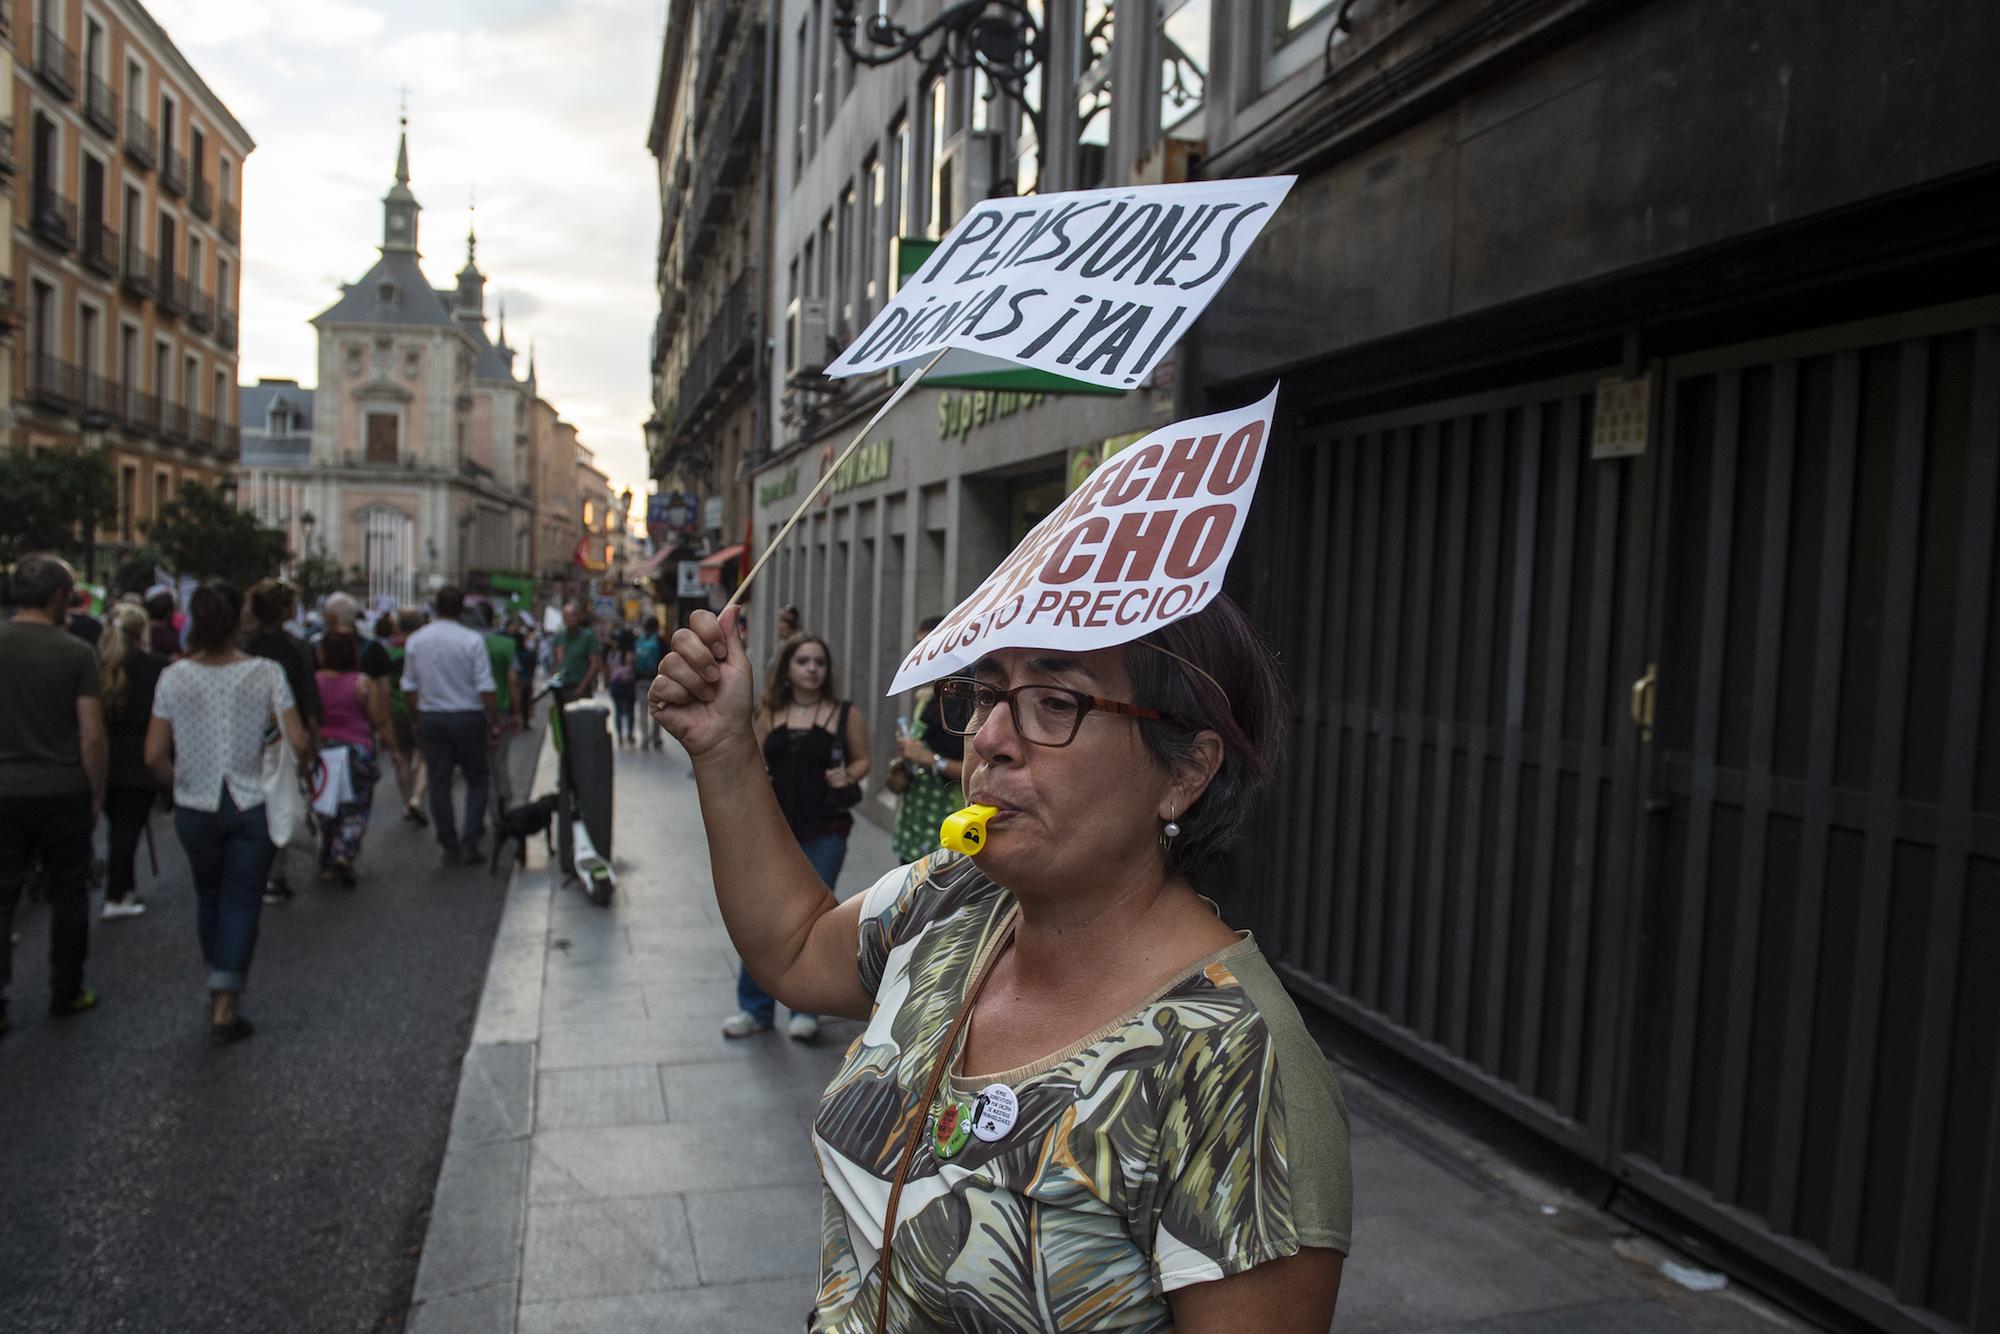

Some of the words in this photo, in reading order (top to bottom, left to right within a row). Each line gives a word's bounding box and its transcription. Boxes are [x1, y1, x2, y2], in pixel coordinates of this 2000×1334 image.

[922, 195, 1269, 290] PENSIONES
[847, 288, 1048, 366] DIGNAS
[1016, 294, 1187, 385] ¡YA!
[903, 639, 931, 672] A
[927, 593, 1025, 661] JUSTO
[1025, 581, 1210, 628] PRECIO!
